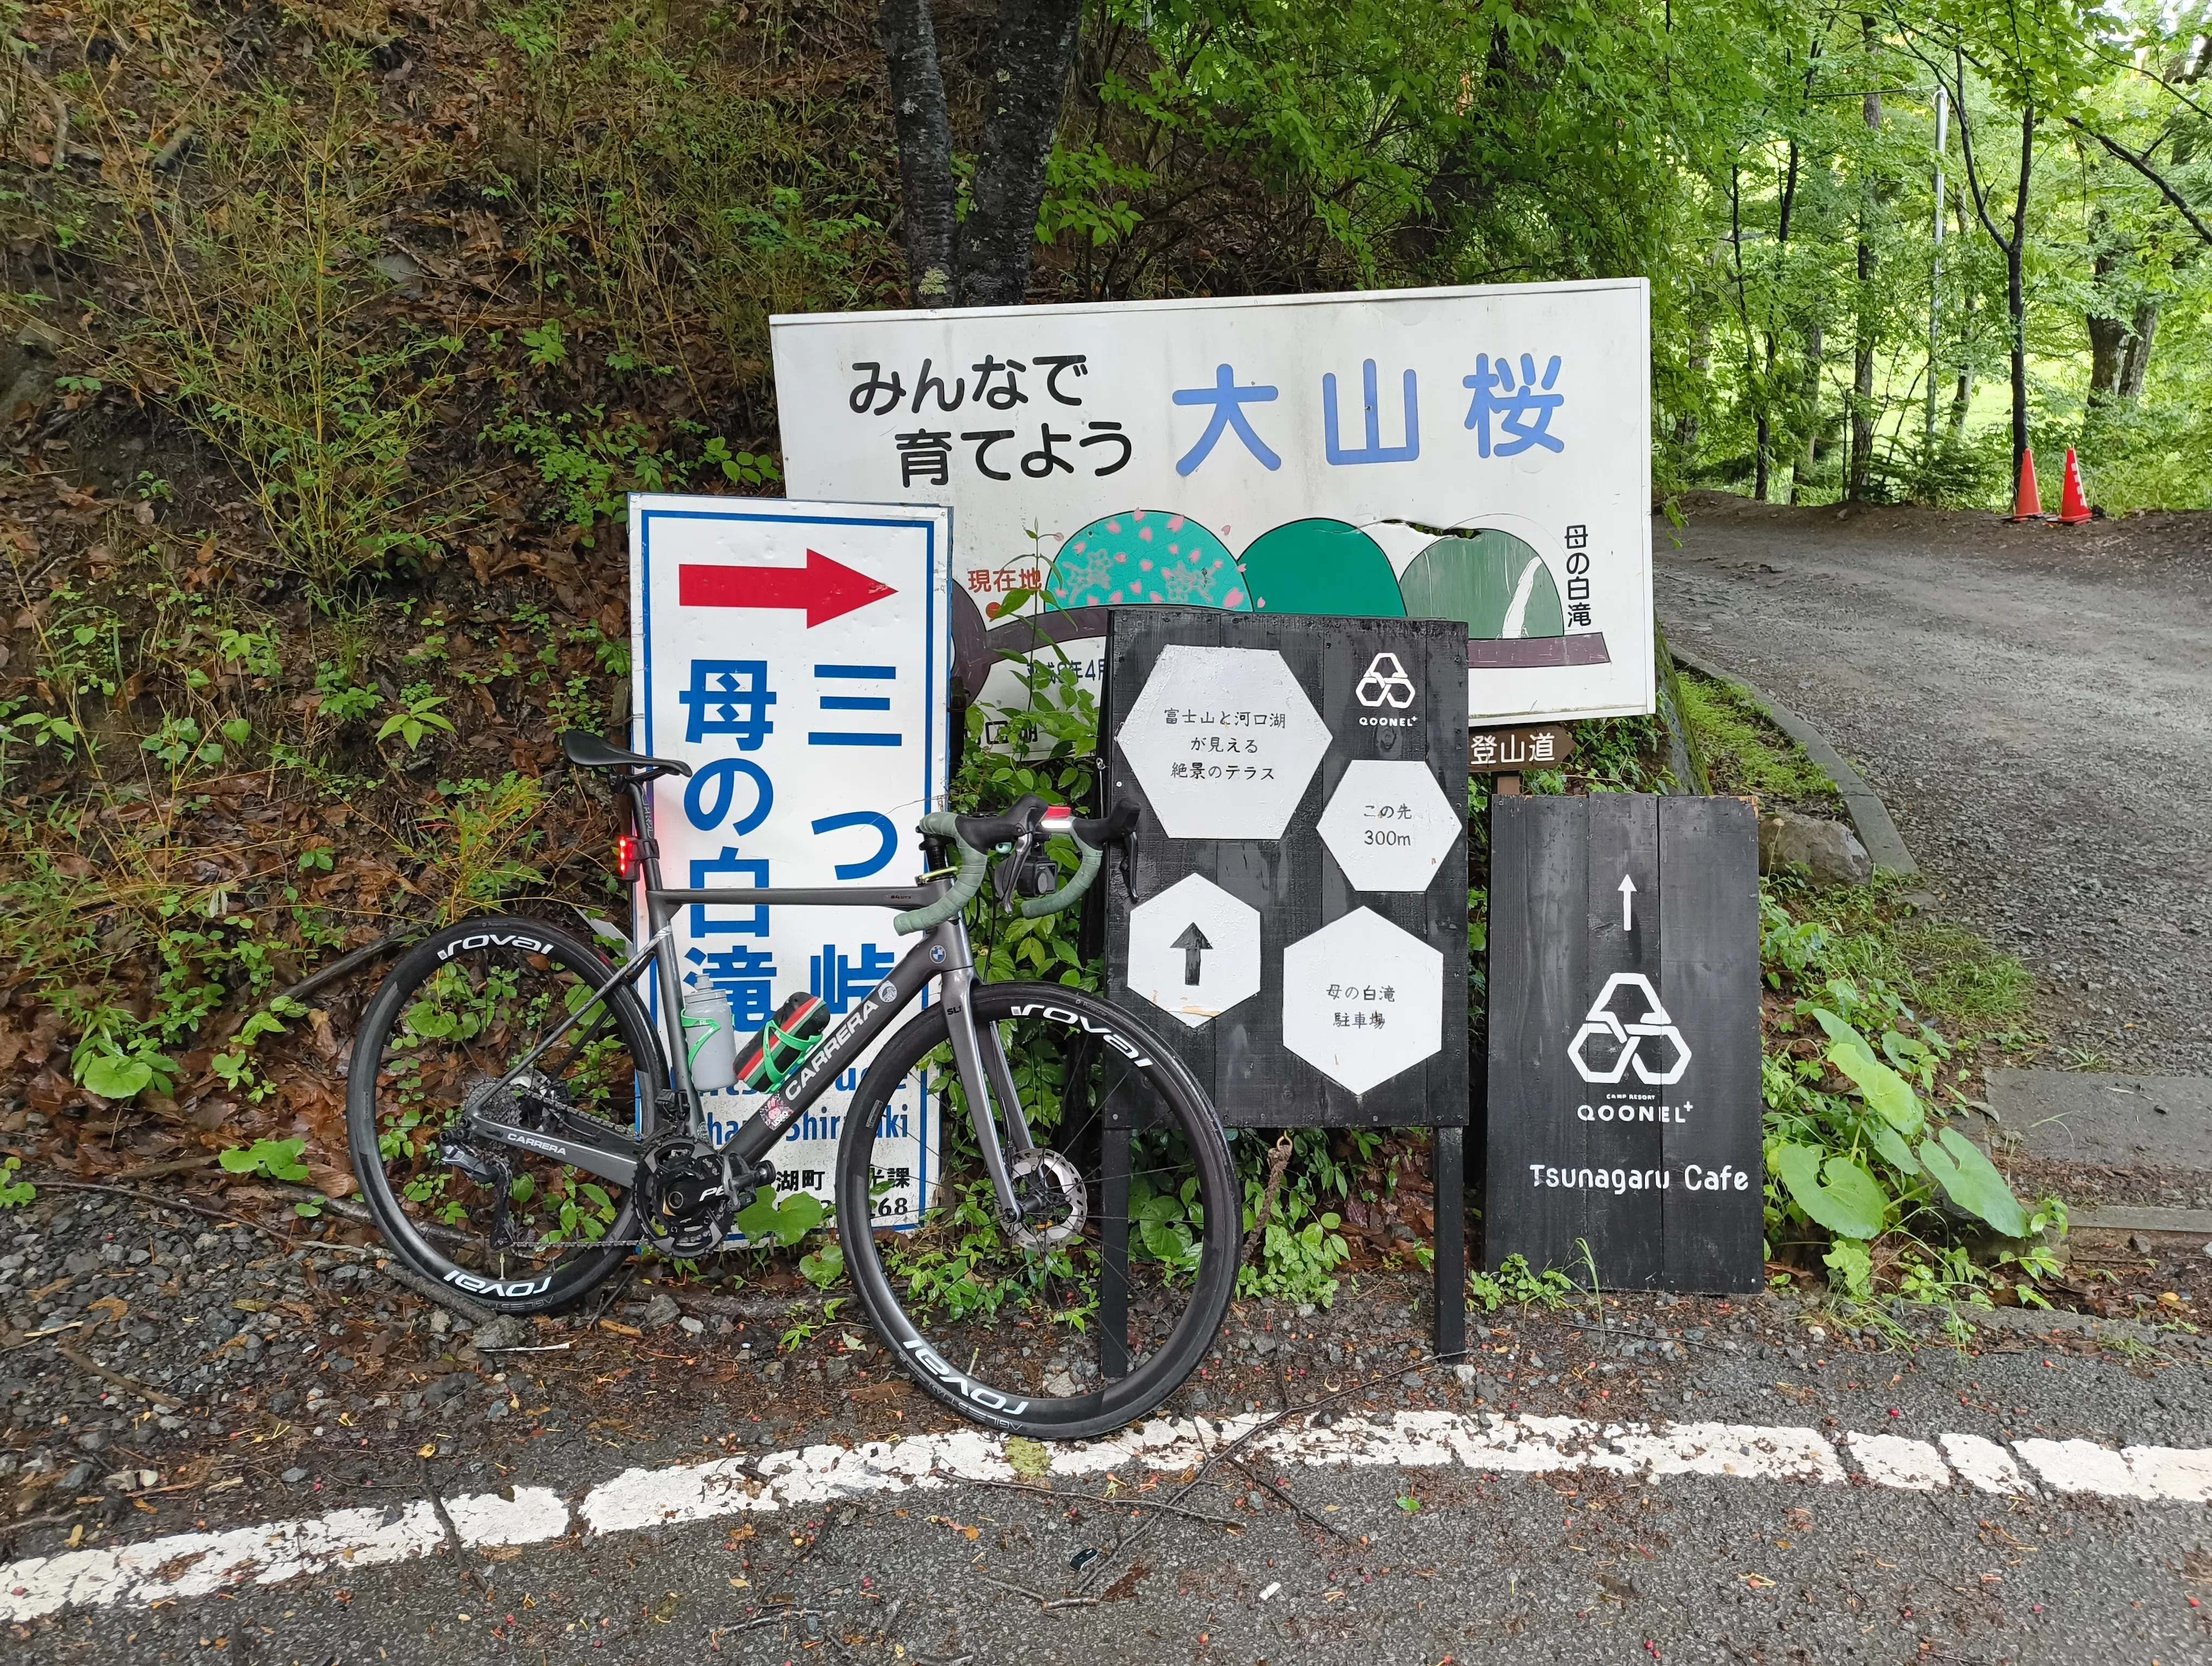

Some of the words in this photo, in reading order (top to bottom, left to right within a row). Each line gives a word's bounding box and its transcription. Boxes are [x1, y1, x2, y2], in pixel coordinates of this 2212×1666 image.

[849, 354, 1089, 415] みんなで
[1172, 353, 1565, 476] 大山桜
[894, 421, 1132, 488] 育てよう
[967, 567, 1042, 593] 現在地
[1563, 524, 1593, 628] 母の白滝
[1163, 708, 1287, 729] 富士山と河口湖
[1190, 737, 1258, 754] が見える
[1470, 732, 1555, 765] 登山道
[1170, 762, 1275, 781] 絶景のテラス
[1363, 804, 1412, 820] この先
[679, 659, 777, 1032] 母の白滝
[808, 664, 902, 1014] 三つ峠
[1364, 831, 1411, 847] 300m
[445, 934, 554, 958] roval
[1326, 984, 1395, 1003] 母の白滝
[947, 1005, 961, 1015] SL1
[1333, 1012, 1385, 1030] 駐車場
[1020, 1004, 1154, 1067] roval
[785, 1001, 879, 1100] CARRERA
[507, 1132, 567, 1156] CARRERA
[1529, 1164, 1670, 1195] Tsunagaru
[1684, 1164, 1749, 1191] Cafe
[443, 1269, 552, 1298] roval
[903, 1339, 1028, 1415] roval
